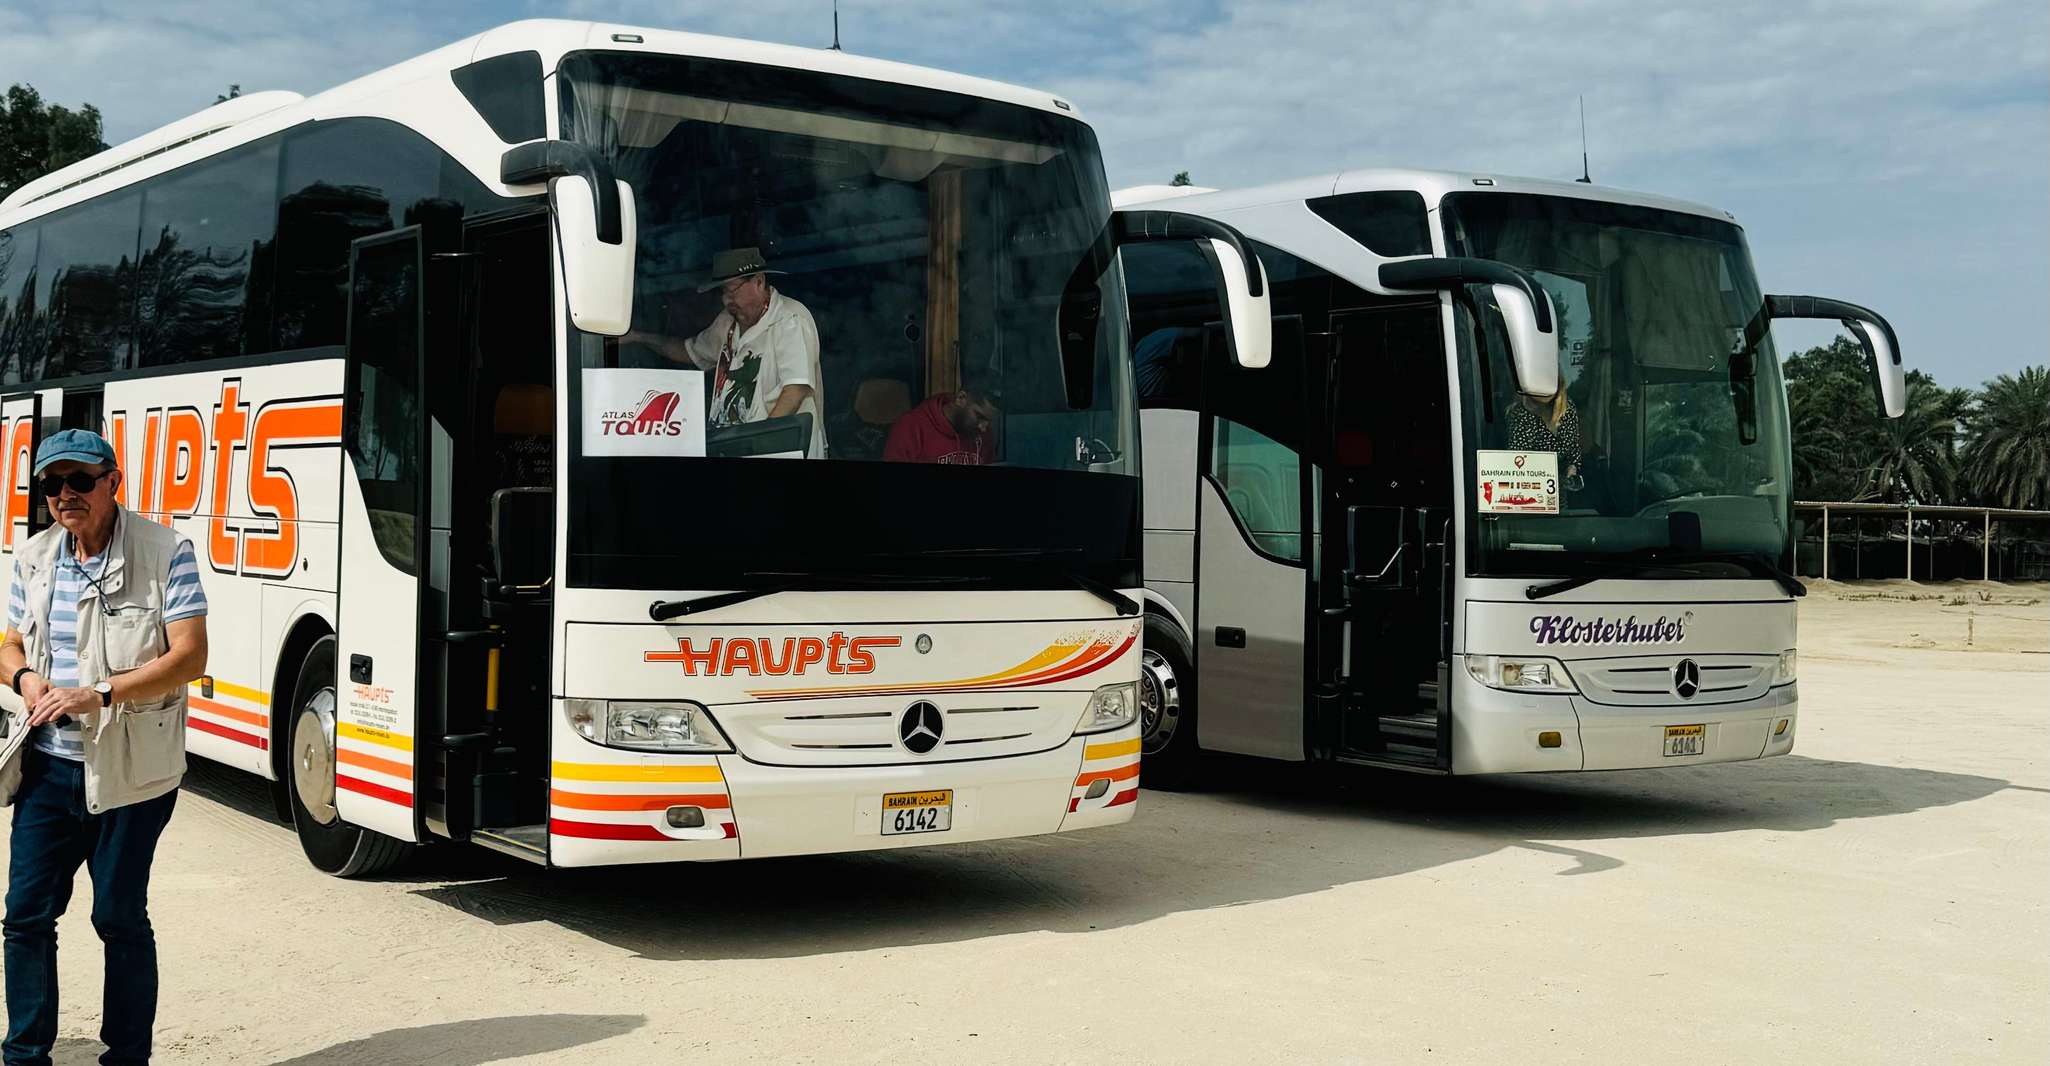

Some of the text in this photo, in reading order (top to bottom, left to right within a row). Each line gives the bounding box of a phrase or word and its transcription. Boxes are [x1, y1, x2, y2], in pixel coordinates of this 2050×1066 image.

[601, 411, 635, 419] ATLAS
[601, 420, 682, 436] TOURS
[1480, 469, 1511, 477] BAHRAIN
[1527, 470, 1546, 478] TOURS
[1546, 478, 1556, 495] 3
[1529, 614, 1685, 646] Klosterhuber
[888, 796, 917, 807] BAHRAIN
[894, 807, 938, 832] 6142
